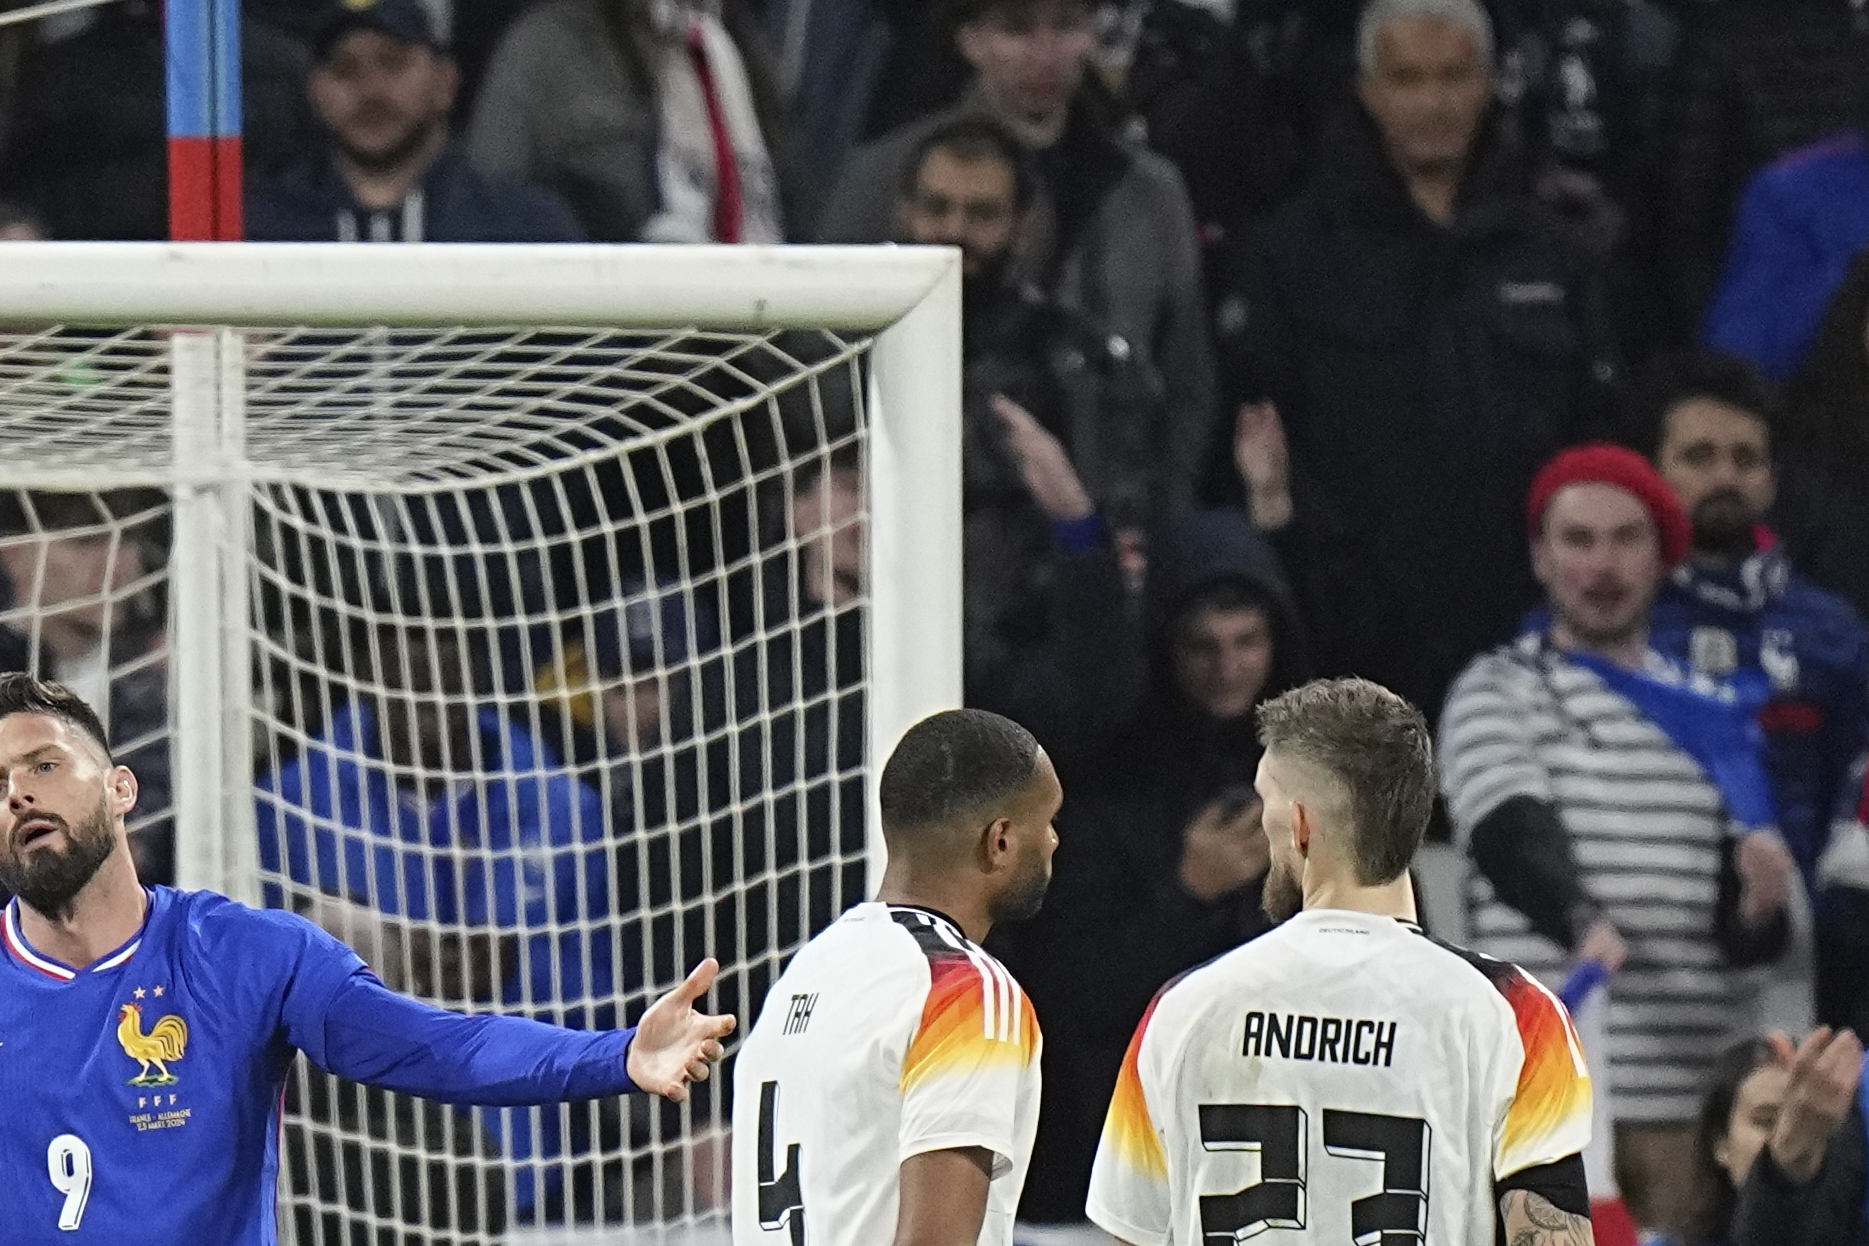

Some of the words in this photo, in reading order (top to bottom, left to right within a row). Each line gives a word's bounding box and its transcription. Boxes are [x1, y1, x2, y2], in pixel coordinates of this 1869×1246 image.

[782, 992, 819, 1036] TAH
[1242, 1010, 1397, 1067] ANDRICH
[47, 1133, 93, 1231] 9
